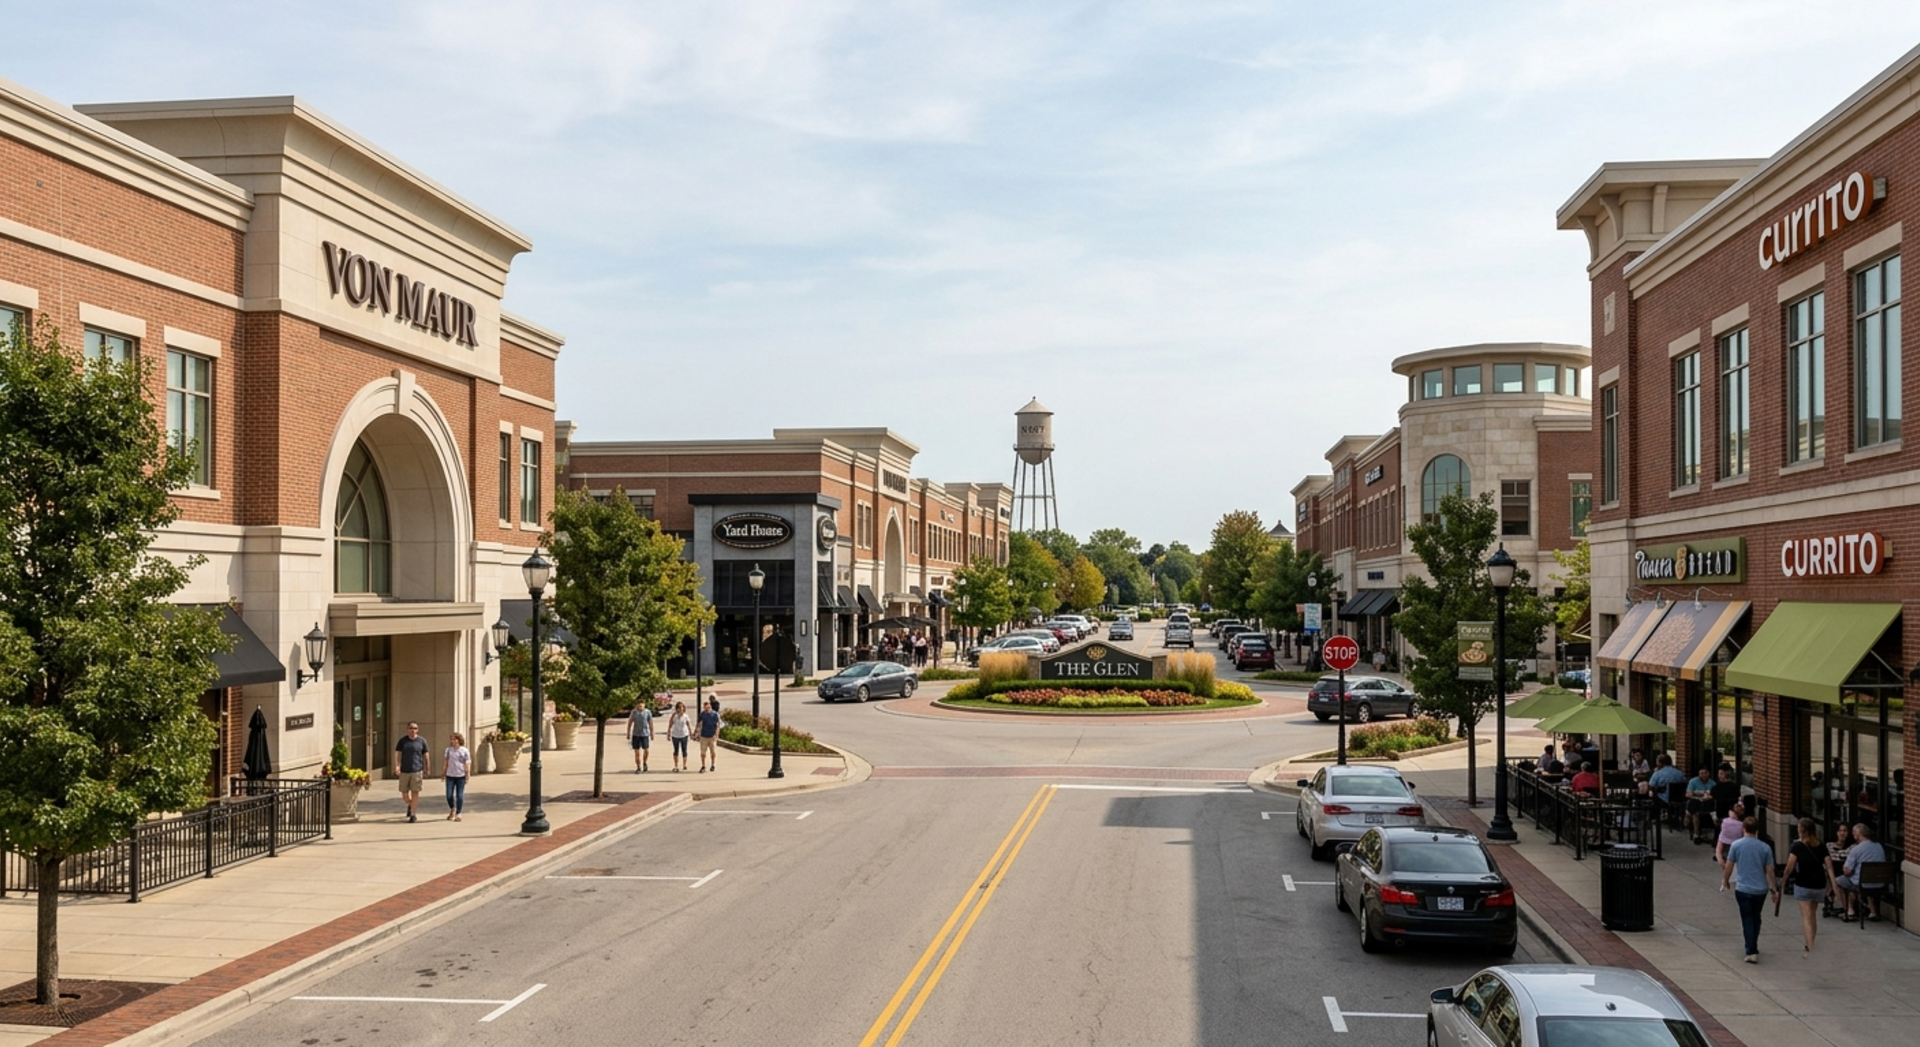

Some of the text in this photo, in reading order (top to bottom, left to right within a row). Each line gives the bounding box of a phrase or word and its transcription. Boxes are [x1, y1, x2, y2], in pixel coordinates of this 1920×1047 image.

[322, 240, 479, 349] VON MAUR
[723, 524, 748, 537] Yard
[1780, 532, 1878, 577] CURRITO
[1325, 646, 1357, 660] STOP
[1054, 661, 1140, 676] THE GLEN
